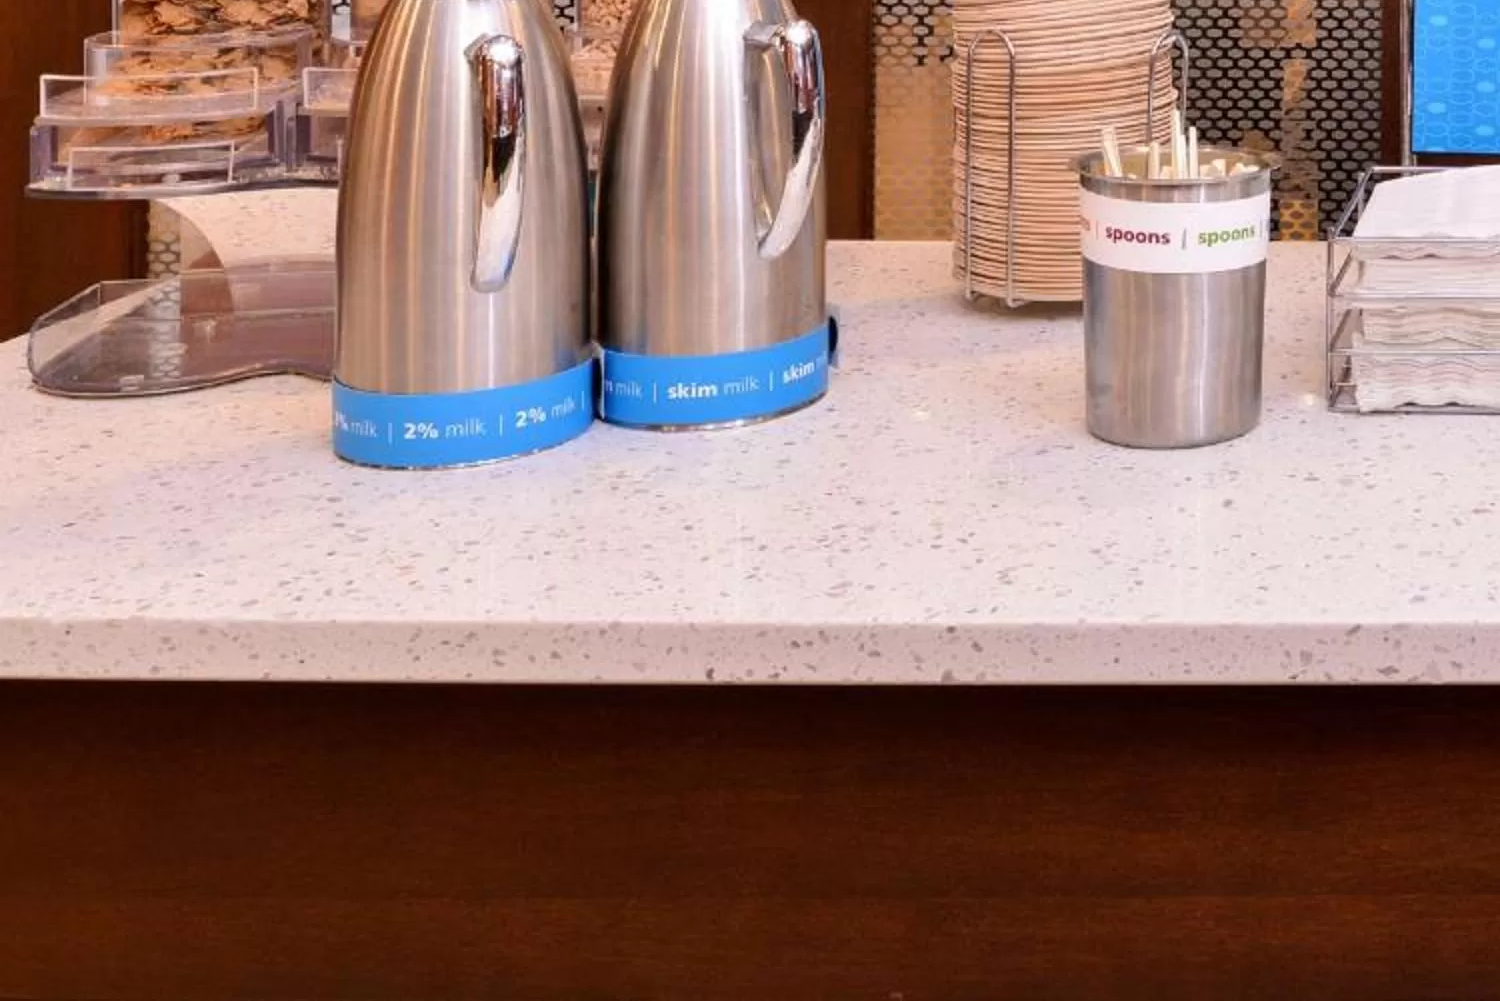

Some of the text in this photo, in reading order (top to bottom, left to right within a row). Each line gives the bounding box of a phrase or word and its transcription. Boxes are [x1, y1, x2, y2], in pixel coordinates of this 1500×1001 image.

[1105, 224, 1256, 247] spoons spoons
[615, 381, 642, 396] milk
[667, 380, 718, 400] skim
[722, 375, 761, 396] milk
[782, 359, 816, 384] skim
[350, 419, 377, 438] milk
[403, 421, 440, 440] 2%
[444, 418, 487, 438] milk
[514, 405, 547, 429] 2%
[550, 395, 576, 418] milk
